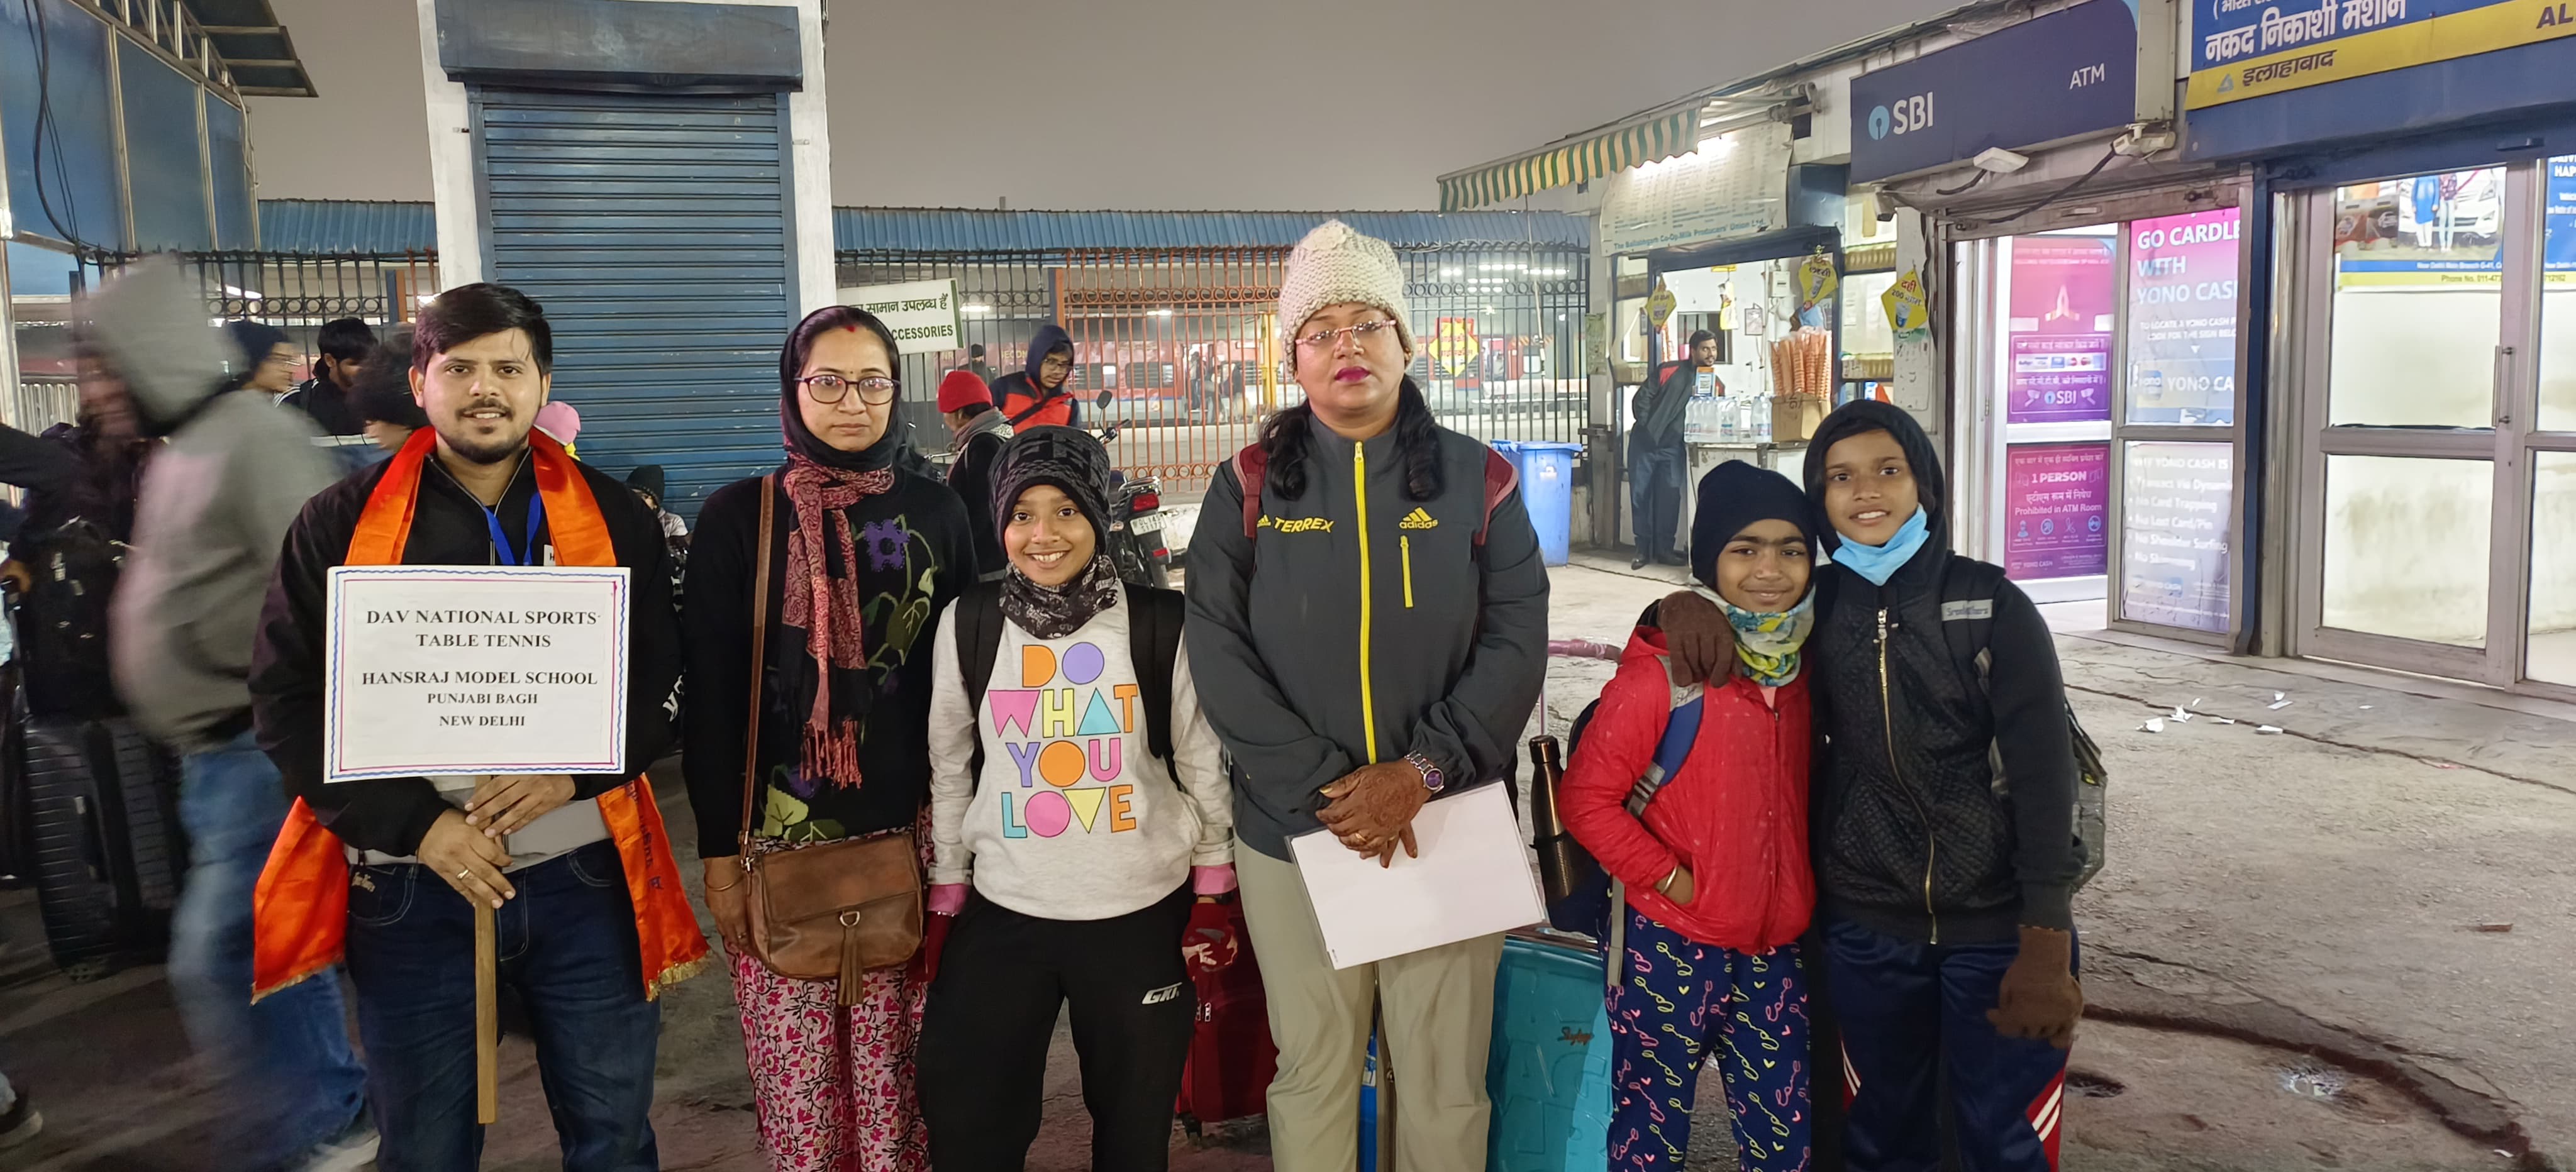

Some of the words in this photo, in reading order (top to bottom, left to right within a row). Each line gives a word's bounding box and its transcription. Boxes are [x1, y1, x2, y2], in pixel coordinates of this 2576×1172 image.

[2536, 3, 2576, 29] AL
[2205, 25, 2257, 62] नकद
[2069, 63, 2105, 90] ATM
[2243, 50, 2337, 86] इलाहाबाद
[1892, 92, 1934, 135] SBI
[2138, 229, 2165, 250] GO
[2137, 255, 2186, 277] WITH
[2137, 284, 2190, 304] YONO
[865, 301, 899, 315] सामान
[901, 298, 936, 312] उपलब्ध
[891, 324, 953, 340] CCESSORIES
[2167, 376, 2210, 392] YONO
[2057, 390, 2077, 404] SBI
[2040, 471, 2087, 484] PERSON
[2015, 506, 2053, 516] Prohibited
[2055, 506, 2061, 514] in
[2062, 504, 2079, 512] ATM
[2080, 504, 2102, 512] Room
[1274, 516, 1335, 533] TERREX
[1399, 519, 1439, 529] adidas
[367, 610, 410, 624] DAV
[415, 610, 519, 624] NATIONAL
[416, 634, 479, 647] TABLE
[484, 634, 551, 647] TENNIS
[1022, 641, 1105, 688] DO
[362, 671, 449, 685] HANSRAJ
[455, 671, 521, 685] MODEL
[525, 672, 598, 685] SCHOOL
[427, 693, 491, 704] PUNJABI
[496, 693, 538, 704] BAGH
[987, 683, 1138, 738] WHAT
[439, 716, 475, 726] NEW
[479, 716, 526, 727] DELHI
[1005, 737, 1122, 788] YOU
[1001, 784, 1136, 839] LOVE
